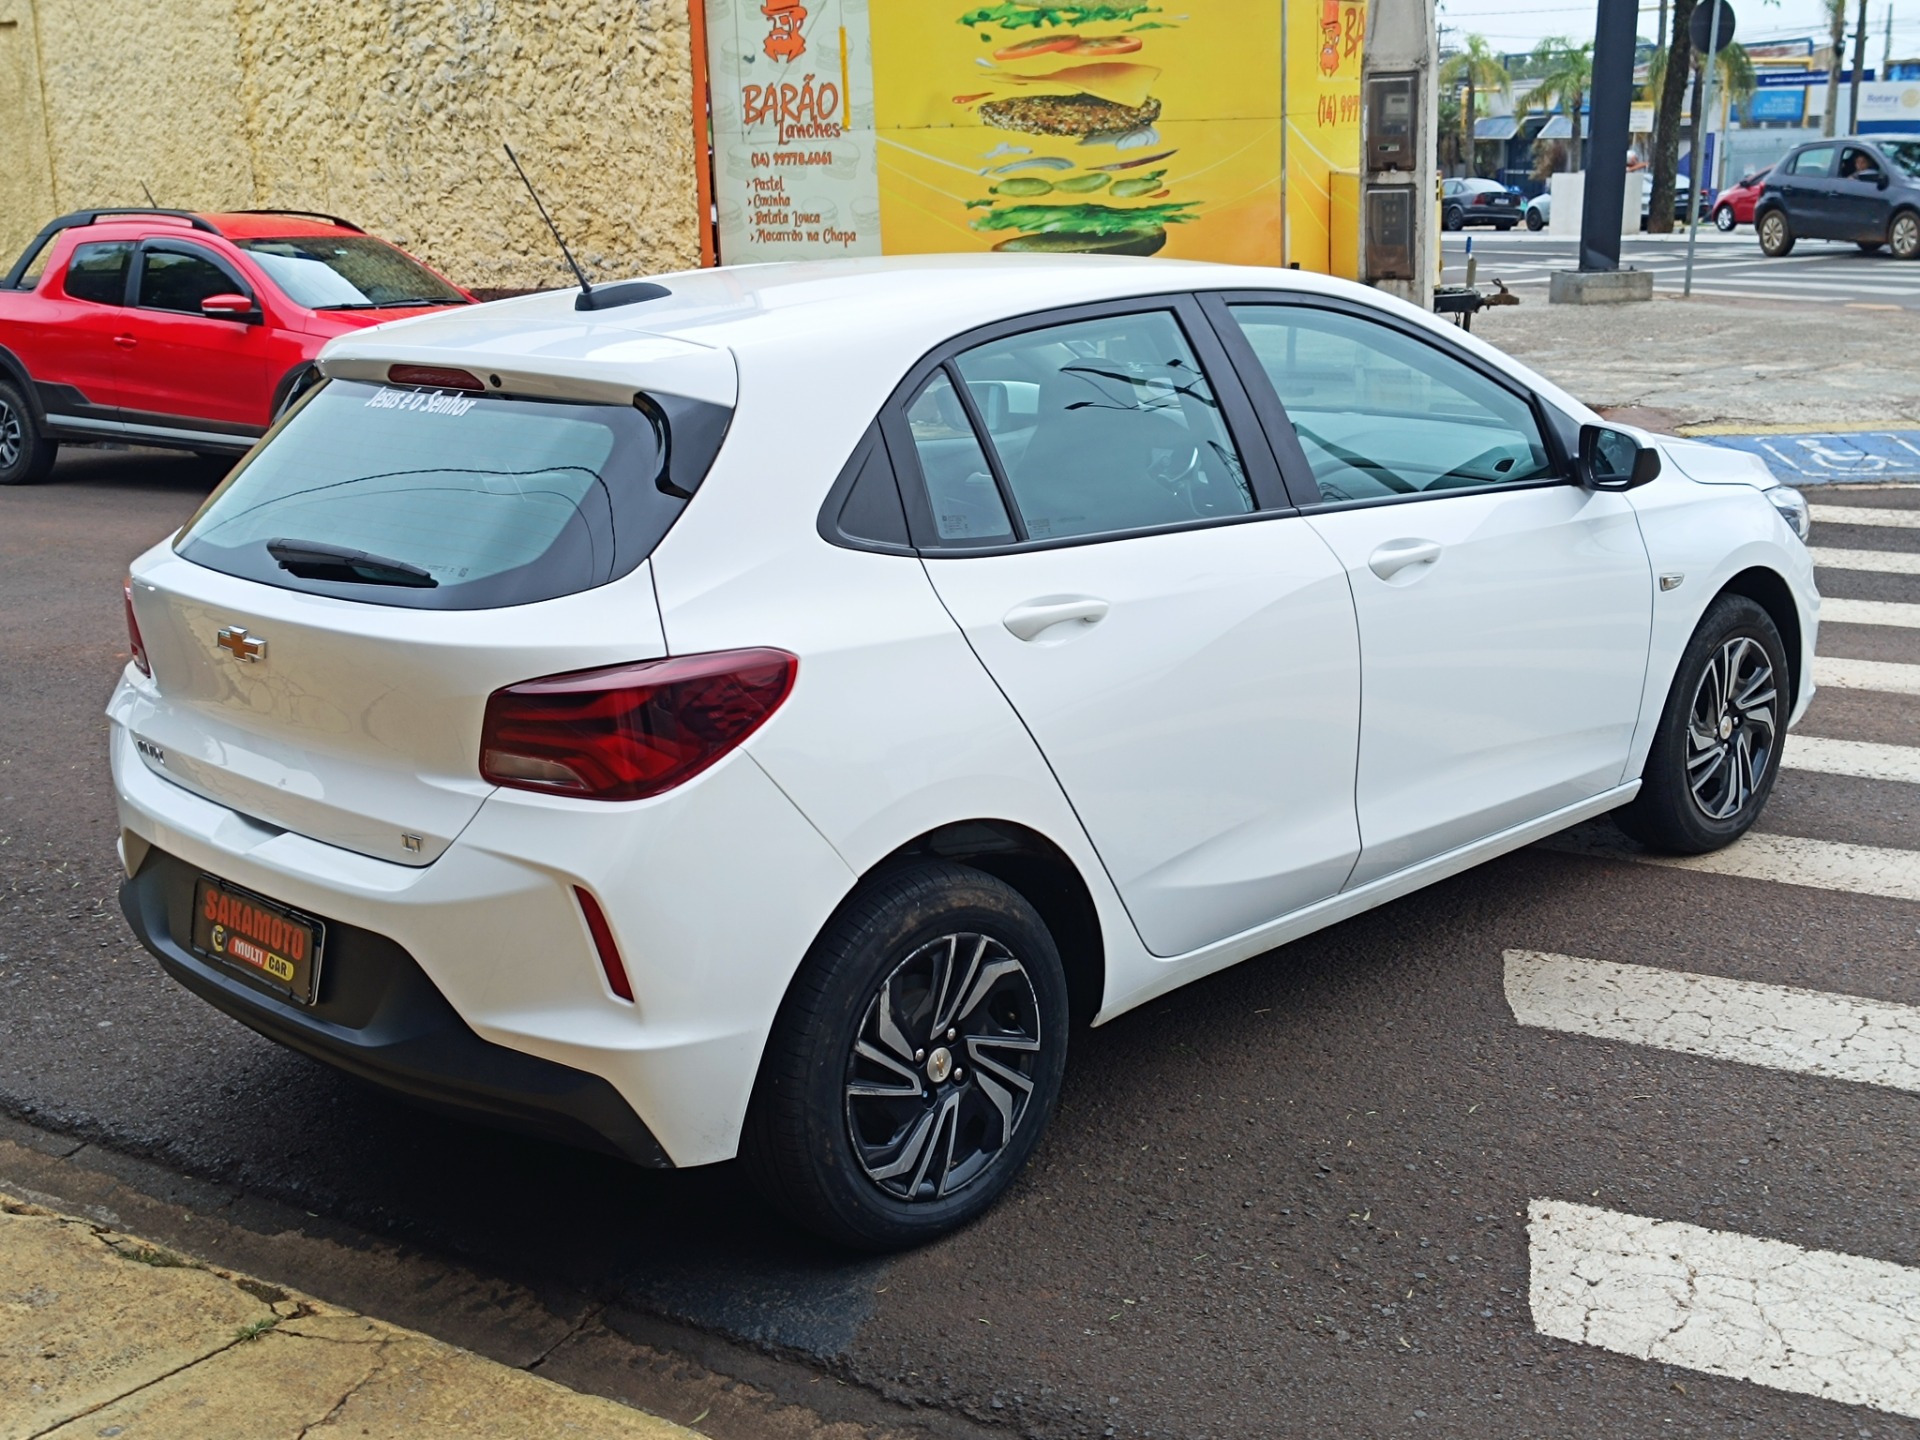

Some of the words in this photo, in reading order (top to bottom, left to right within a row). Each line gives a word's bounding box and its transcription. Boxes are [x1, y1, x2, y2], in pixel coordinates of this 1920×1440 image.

[742, 74, 838, 126] BARÃO
[1318, 94, 1336, 128] (14)
[1341, 95, 1360, 122] 997
[778, 115, 841, 145] Lanches
[751, 152, 770, 168] (14)
[753, 175, 785, 192] Pastel
[753, 192, 791, 208] Coxinha
[755, 209, 788, 225] Batata
[792, 210, 820, 227] Louca
[756, 229, 803, 243] Macarrão
[806, 231, 819, 241] na
[823, 226, 857, 248] Chapa
[365, 386, 405, 409] Jesus
[398, 387, 421, 410] é
[409, 394, 425, 410] o
[419, 390, 477, 416] Senhor
[401, 832, 422, 853] LT
[204, 889, 305, 961] SAKAMOTO
[234, 938, 263, 966] MULTI
[267, 955, 288, 977] CAR
